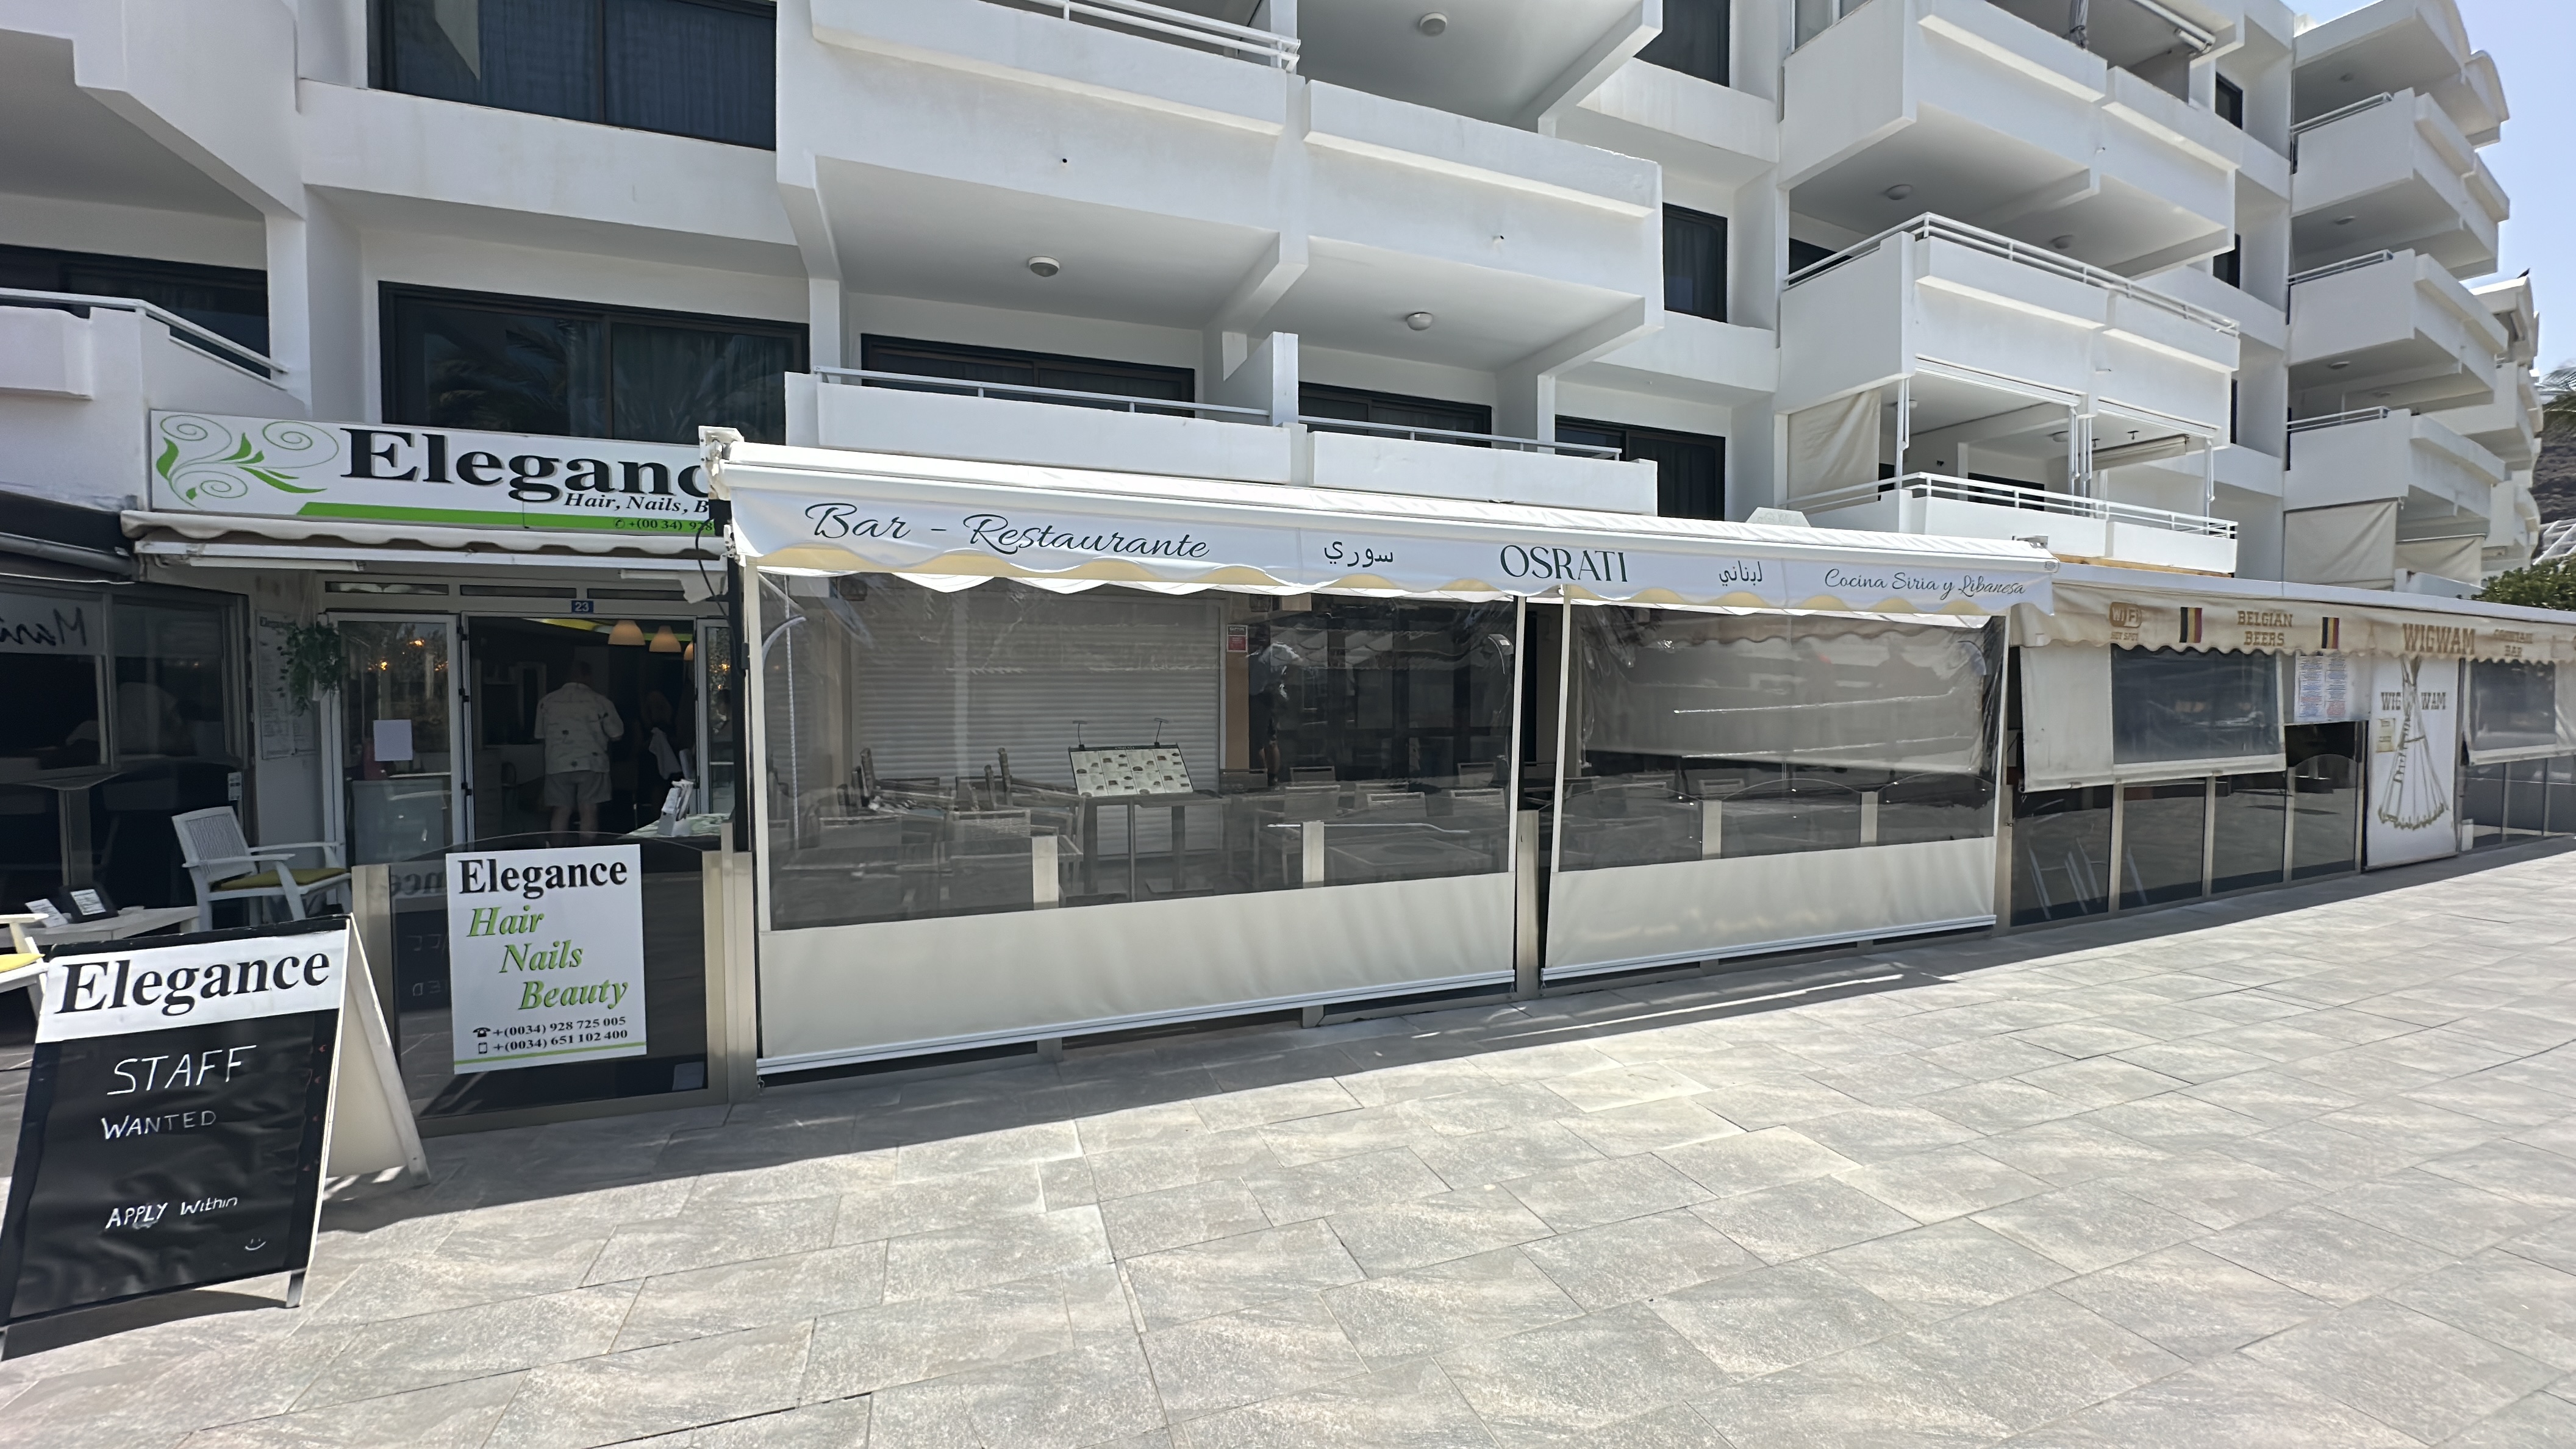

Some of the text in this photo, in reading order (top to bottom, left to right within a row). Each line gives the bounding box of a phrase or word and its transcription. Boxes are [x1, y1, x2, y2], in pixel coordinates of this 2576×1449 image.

[340, 428, 709, 503] Eleganc
[564, 492, 620, 511] Hair,
[661, 518, 682, 531] 34)
[805, 502, 912, 540] Bar
[963, 513, 1210, 559] Restaurante
[1323, 540, 1394, 567] سوري
[1500, 544, 1628, 583] OSRATI
[1718, 559, 1763, 587] لبناني
[1825, 568, 2027, 601] Cocina Siria y Libanesa
[574, 601, 590, 612] 23
[2237, 610, 2294, 628] BELGIAN
[2243, 631, 2285, 646] BEERS
[2402, 623, 2476, 655] WIGWAM
[2421, 692, 2447, 710] WAM
[458, 858, 628, 900] Elegance
[466, 904, 545, 937] Hair
[498, 939, 583, 973] Nails
[54, 951, 331, 1017] Elegance
[518, 979, 629, 1010] Beauty
[492, 1016, 626, 1038] +(0034) 928 725 005
[493, 1029, 628, 1053] +(0034) 651 102 400
[107, 1044, 257, 1096] STAFF
[101, 1110, 216, 1140] WANTED
[105, 1202, 168, 1229] APPLY
